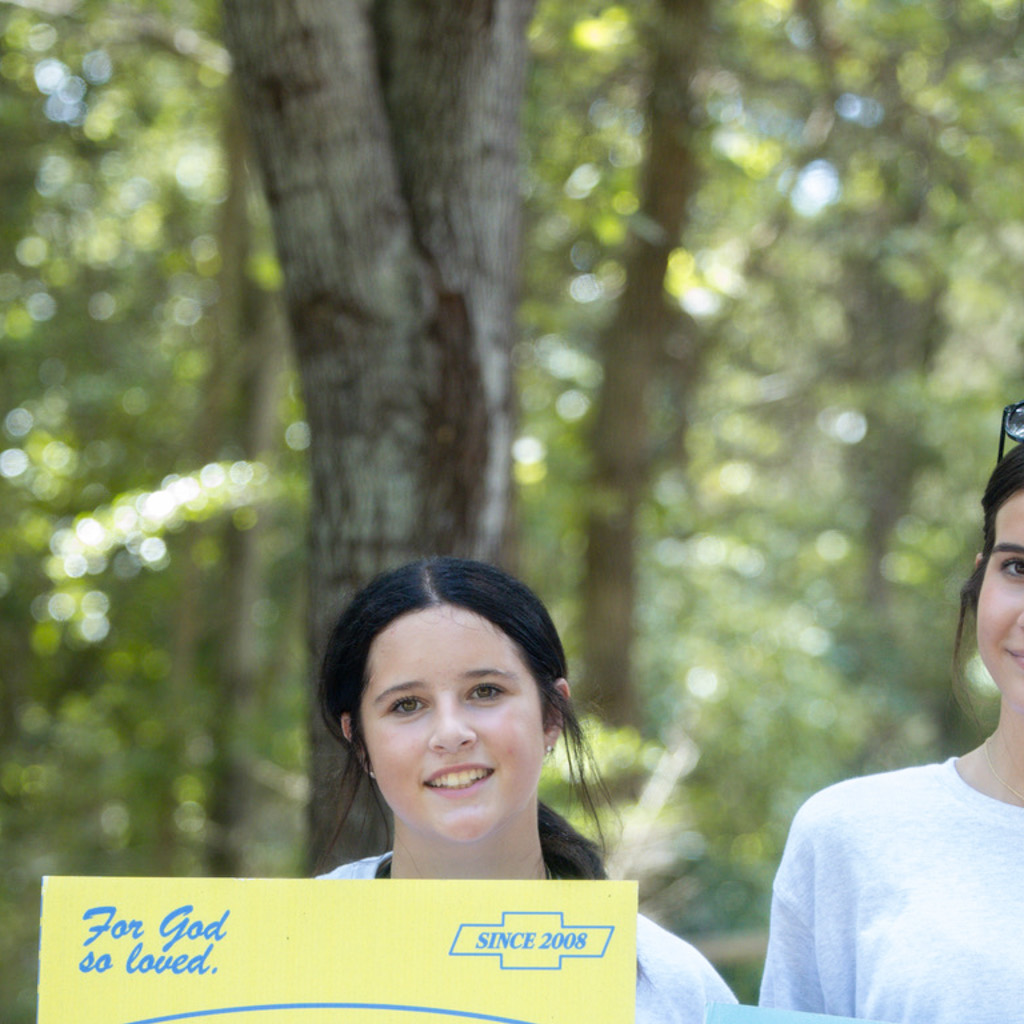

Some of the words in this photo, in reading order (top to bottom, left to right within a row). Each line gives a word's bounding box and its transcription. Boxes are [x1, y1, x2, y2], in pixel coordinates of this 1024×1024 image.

[82, 905, 145, 947] For
[159, 904, 231, 953] God
[475, 931, 537, 949] SINCE
[538, 932, 588, 950] 2008
[78, 951, 114, 973] so
[126, 942, 218, 975] loved.
